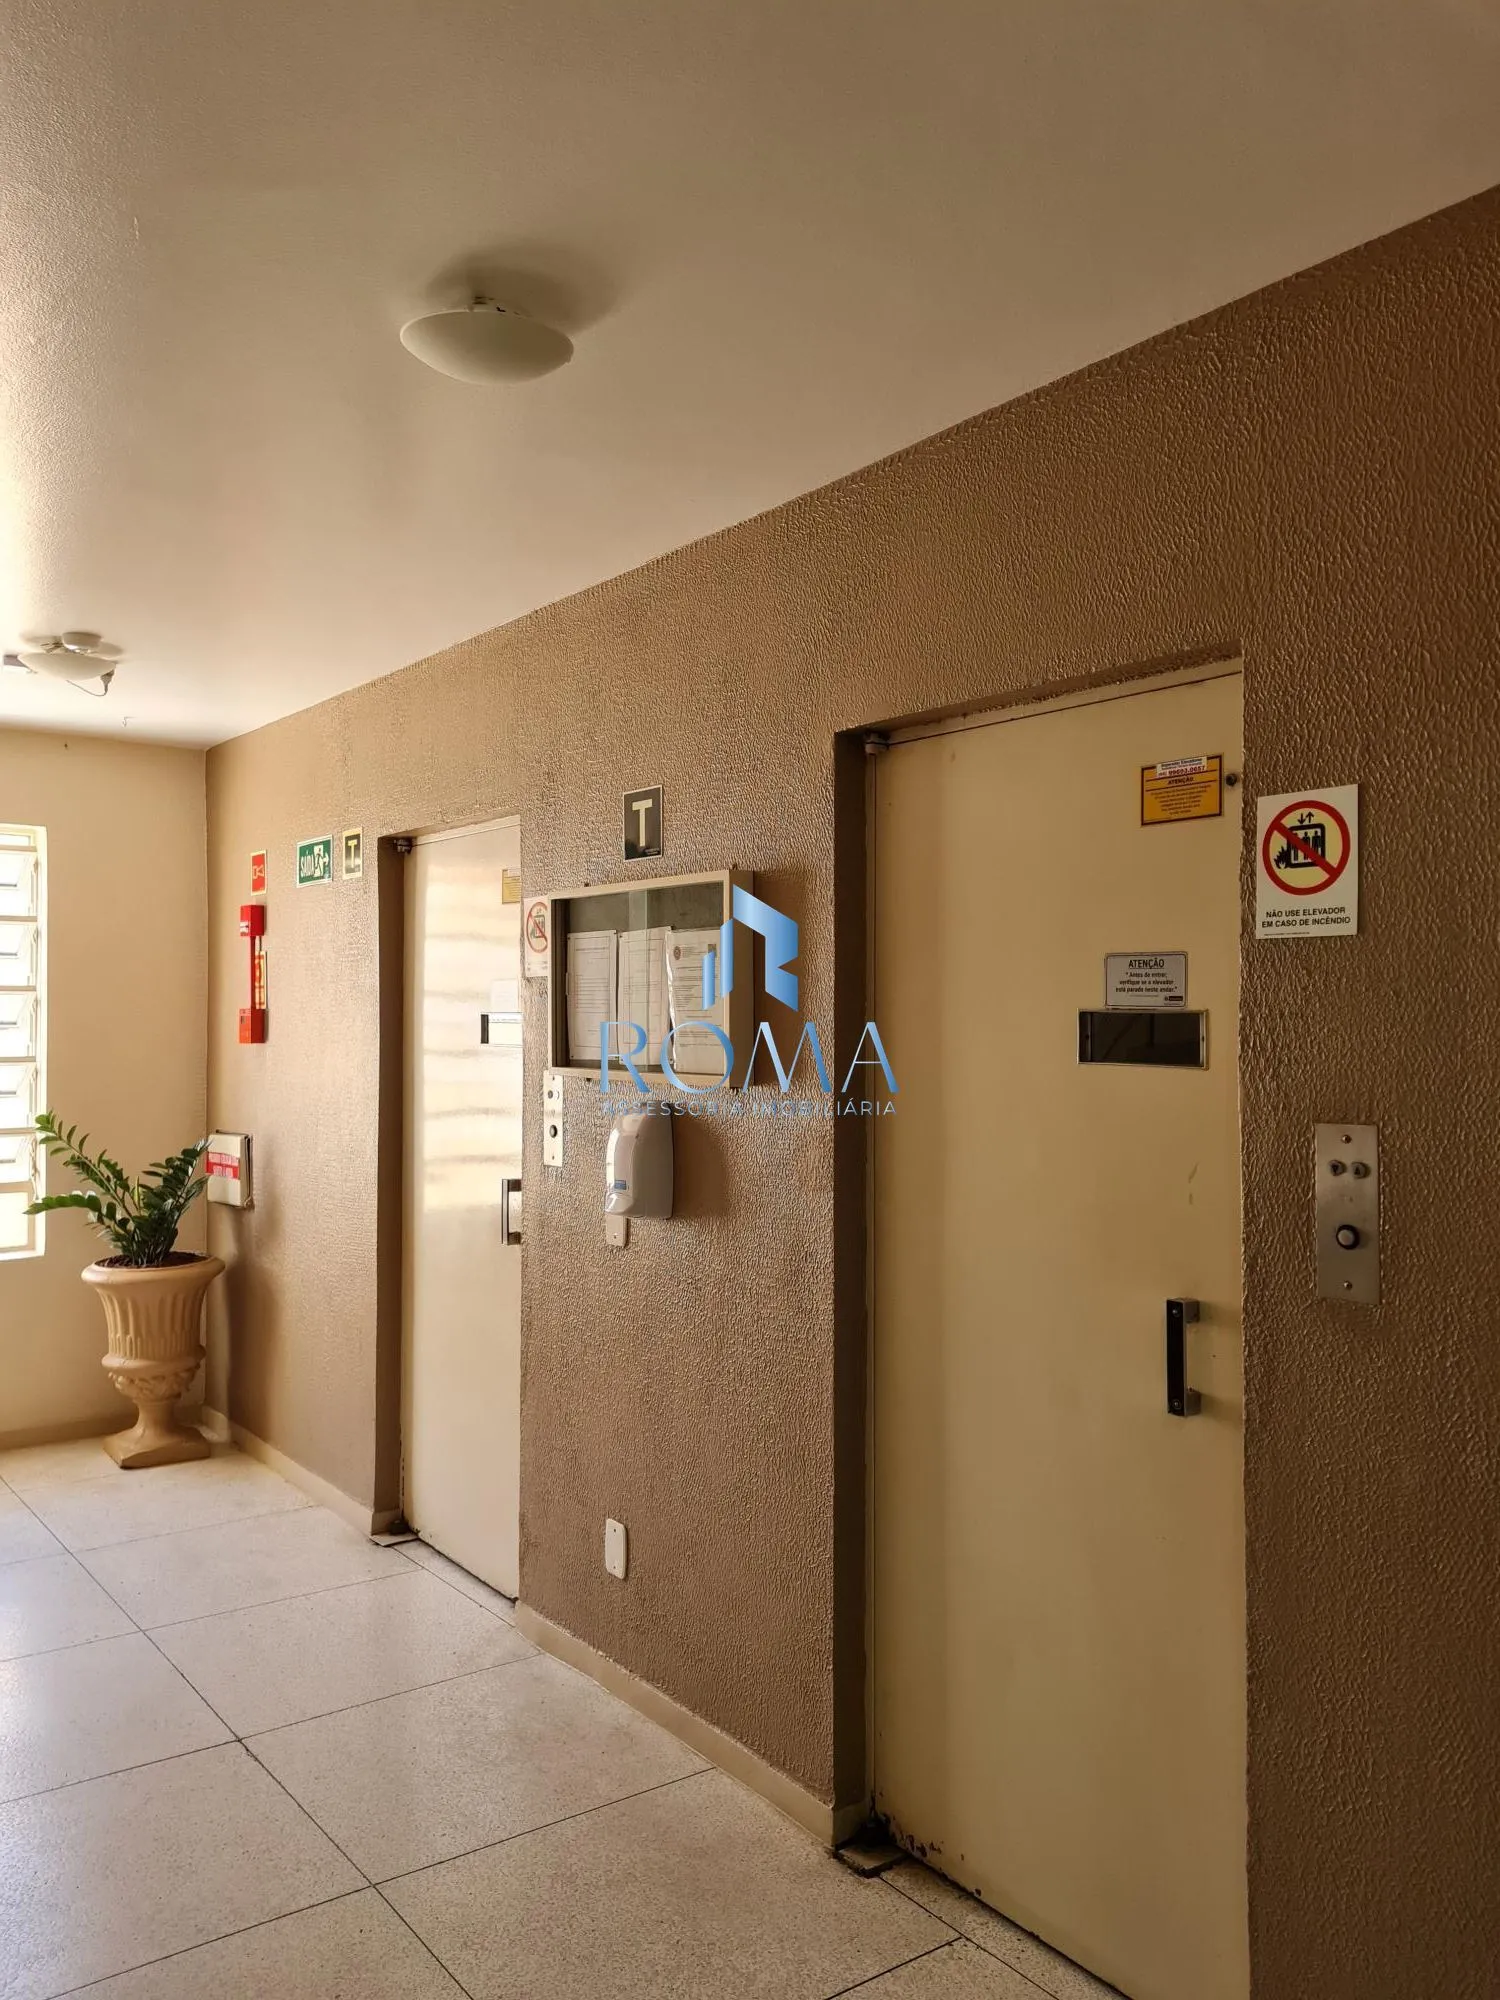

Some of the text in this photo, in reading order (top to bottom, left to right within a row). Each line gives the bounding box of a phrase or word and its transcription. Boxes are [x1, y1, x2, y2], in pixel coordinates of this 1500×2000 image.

[632, 799, 653, 847] T
[347, 839, 358, 869] T
[1266, 907, 1346, 918] NÃO USE ELEVADOR
[1275, 919, 1297, 927] CASO
[1311, 916, 1351, 925] INCÊNDIO
[1128, 957, 1165, 969] ATENÇÃO
